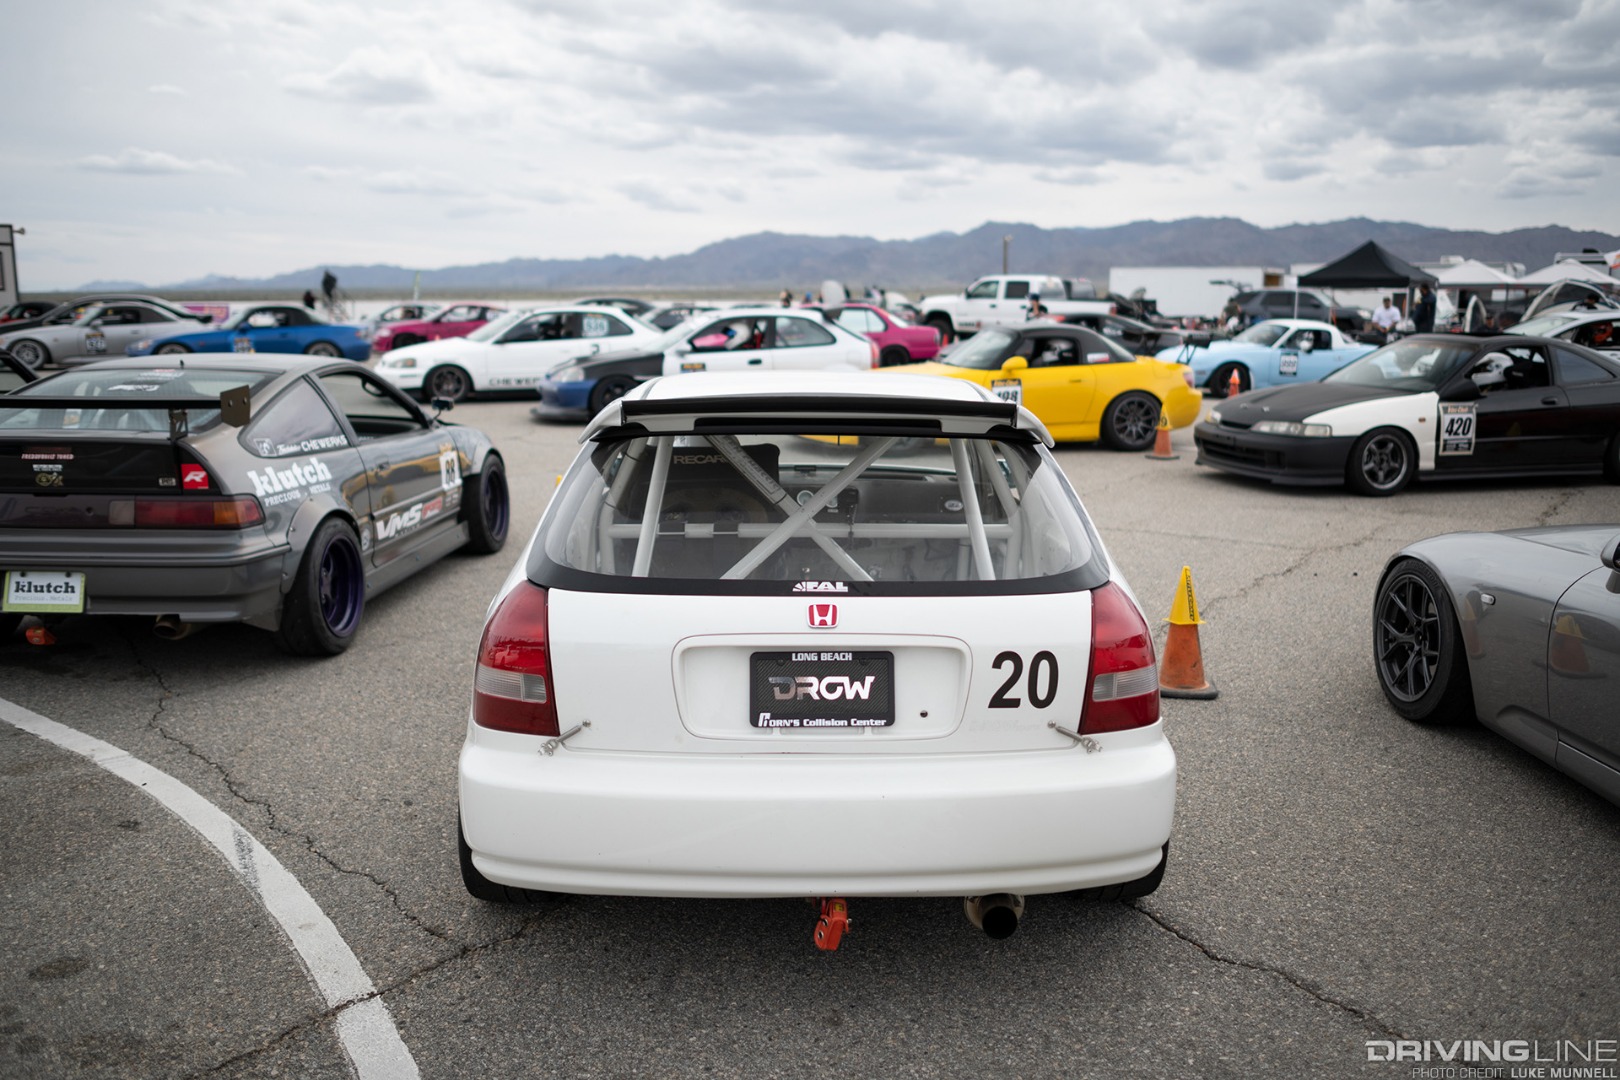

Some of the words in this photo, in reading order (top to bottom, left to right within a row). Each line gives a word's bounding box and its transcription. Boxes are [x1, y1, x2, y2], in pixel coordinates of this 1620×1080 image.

[1445, 417, 1472, 436] 420
[673, 455, 728, 464] RECAR
[247, 457, 332, 497] klutch
[264, 489, 301, 507] PRECIOUS
[309, 482, 331, 495] METALS
[376, 503, 423, 540] VMS
[15, 581, 76, 594] klutch
[792, 653, 818, 661] LONG
[821, 653, 852, 661] BEACH
[988, 650, 1059, 709] 20
[803, 718, 848, 727] Collision
[850, 718, 886, 727] Center
